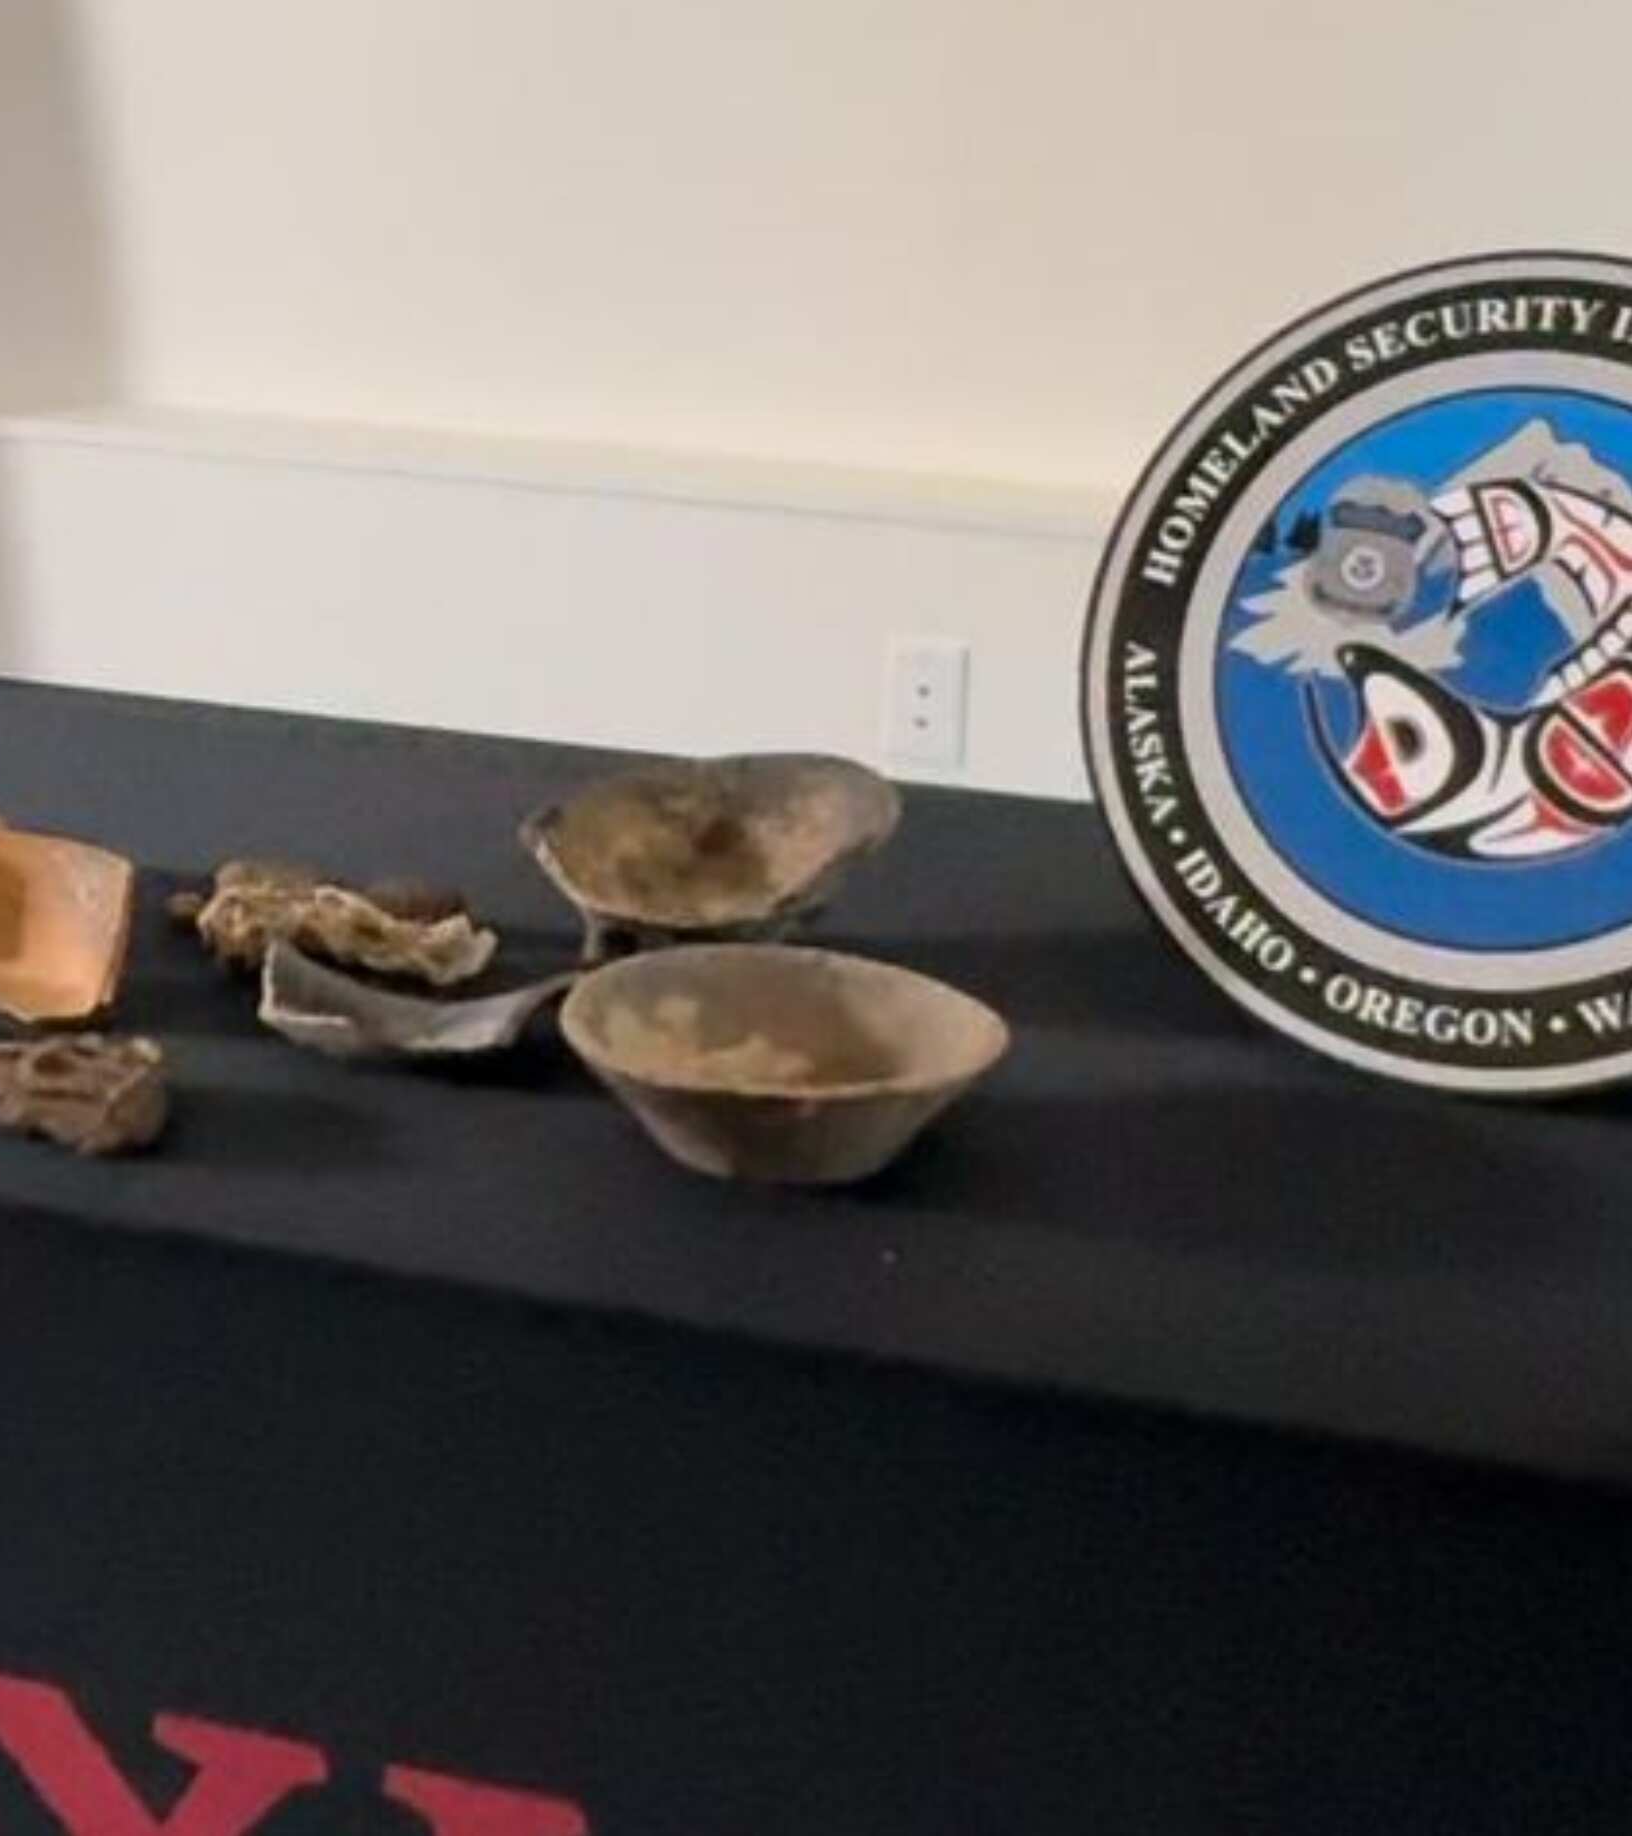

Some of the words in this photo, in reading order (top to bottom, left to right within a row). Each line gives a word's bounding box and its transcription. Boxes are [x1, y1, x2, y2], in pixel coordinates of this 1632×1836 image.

[1144, 354, 1339, 588] HOMELAND
[1344, 296, 1605, 369] SECURITY
[1125, 640, 1177, 825] ALASKA
[1175, 848, 1294, 973] IDAHO
[1324, 974, 1533, 1046] OREGON
